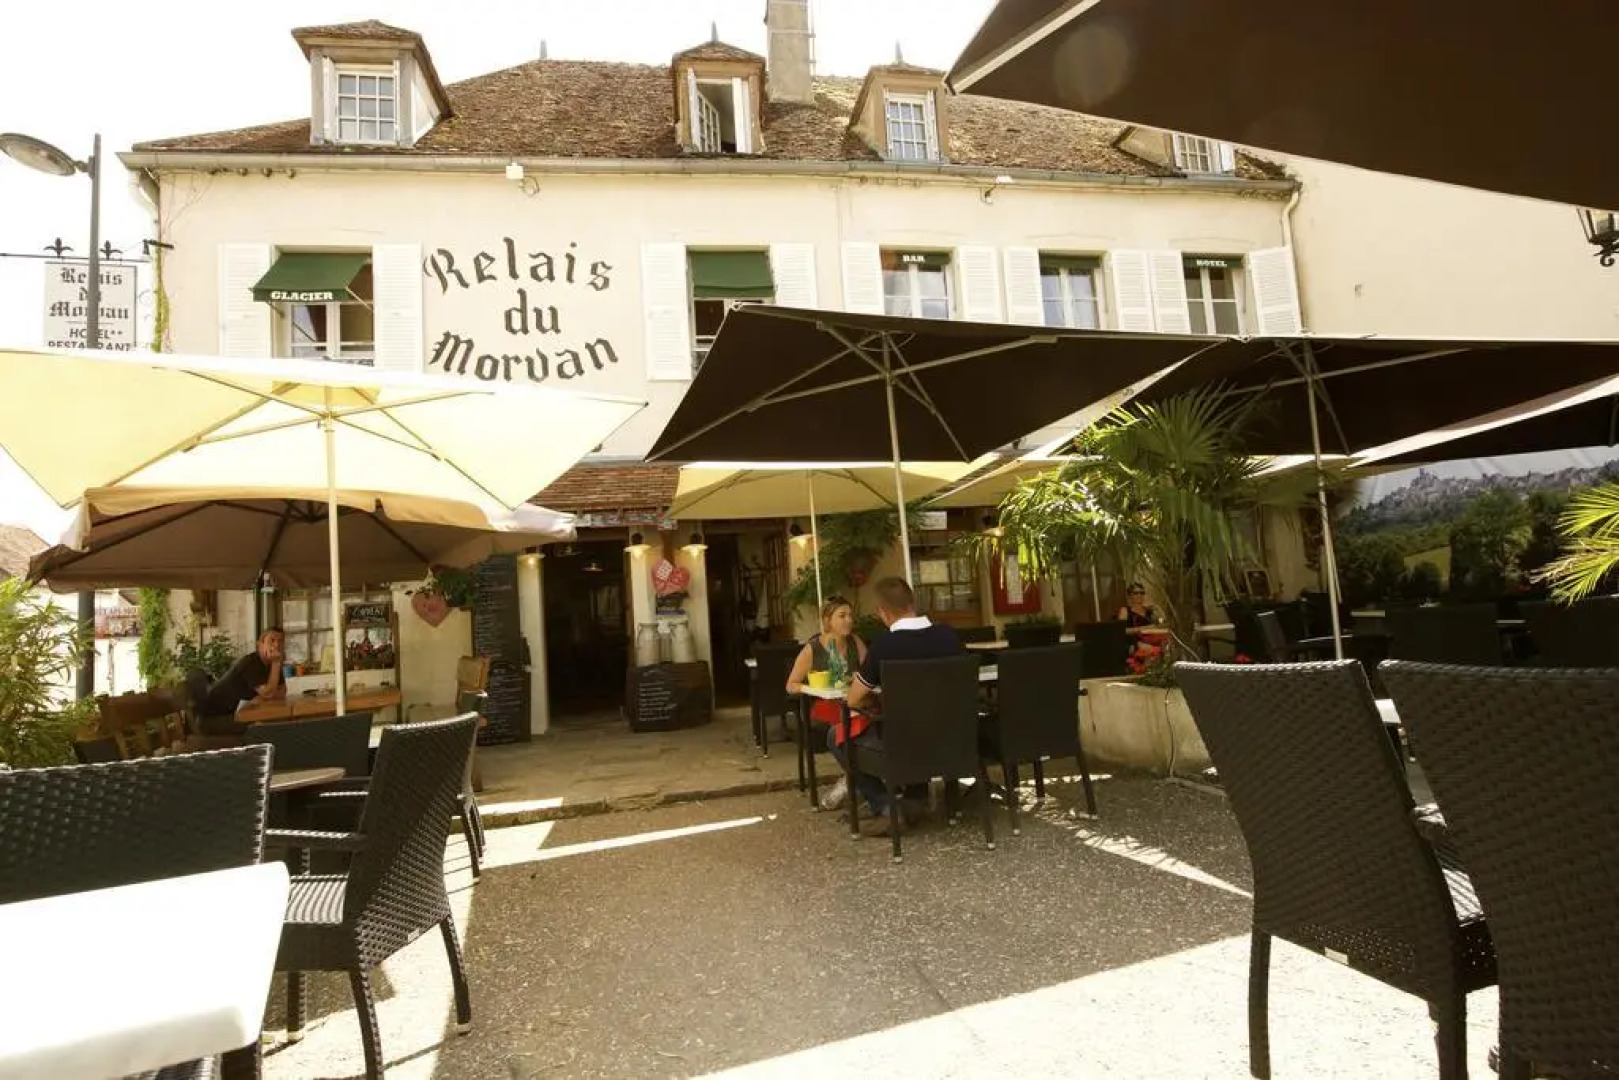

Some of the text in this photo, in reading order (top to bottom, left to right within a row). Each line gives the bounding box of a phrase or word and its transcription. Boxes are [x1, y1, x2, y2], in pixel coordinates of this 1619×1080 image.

[902, 254, 926, 262] BAR
[1196, 259, 1228, 268] HOTEL
[423, 236, 613, 296] Relais
[60, 267, 123, 285] Reis
[270, 290, 334, 301] GLACIER
[504, 287, 562, 335] du
[69, 328, 110, 339] HOEL
[429, 330, 619, 383] Morvan
